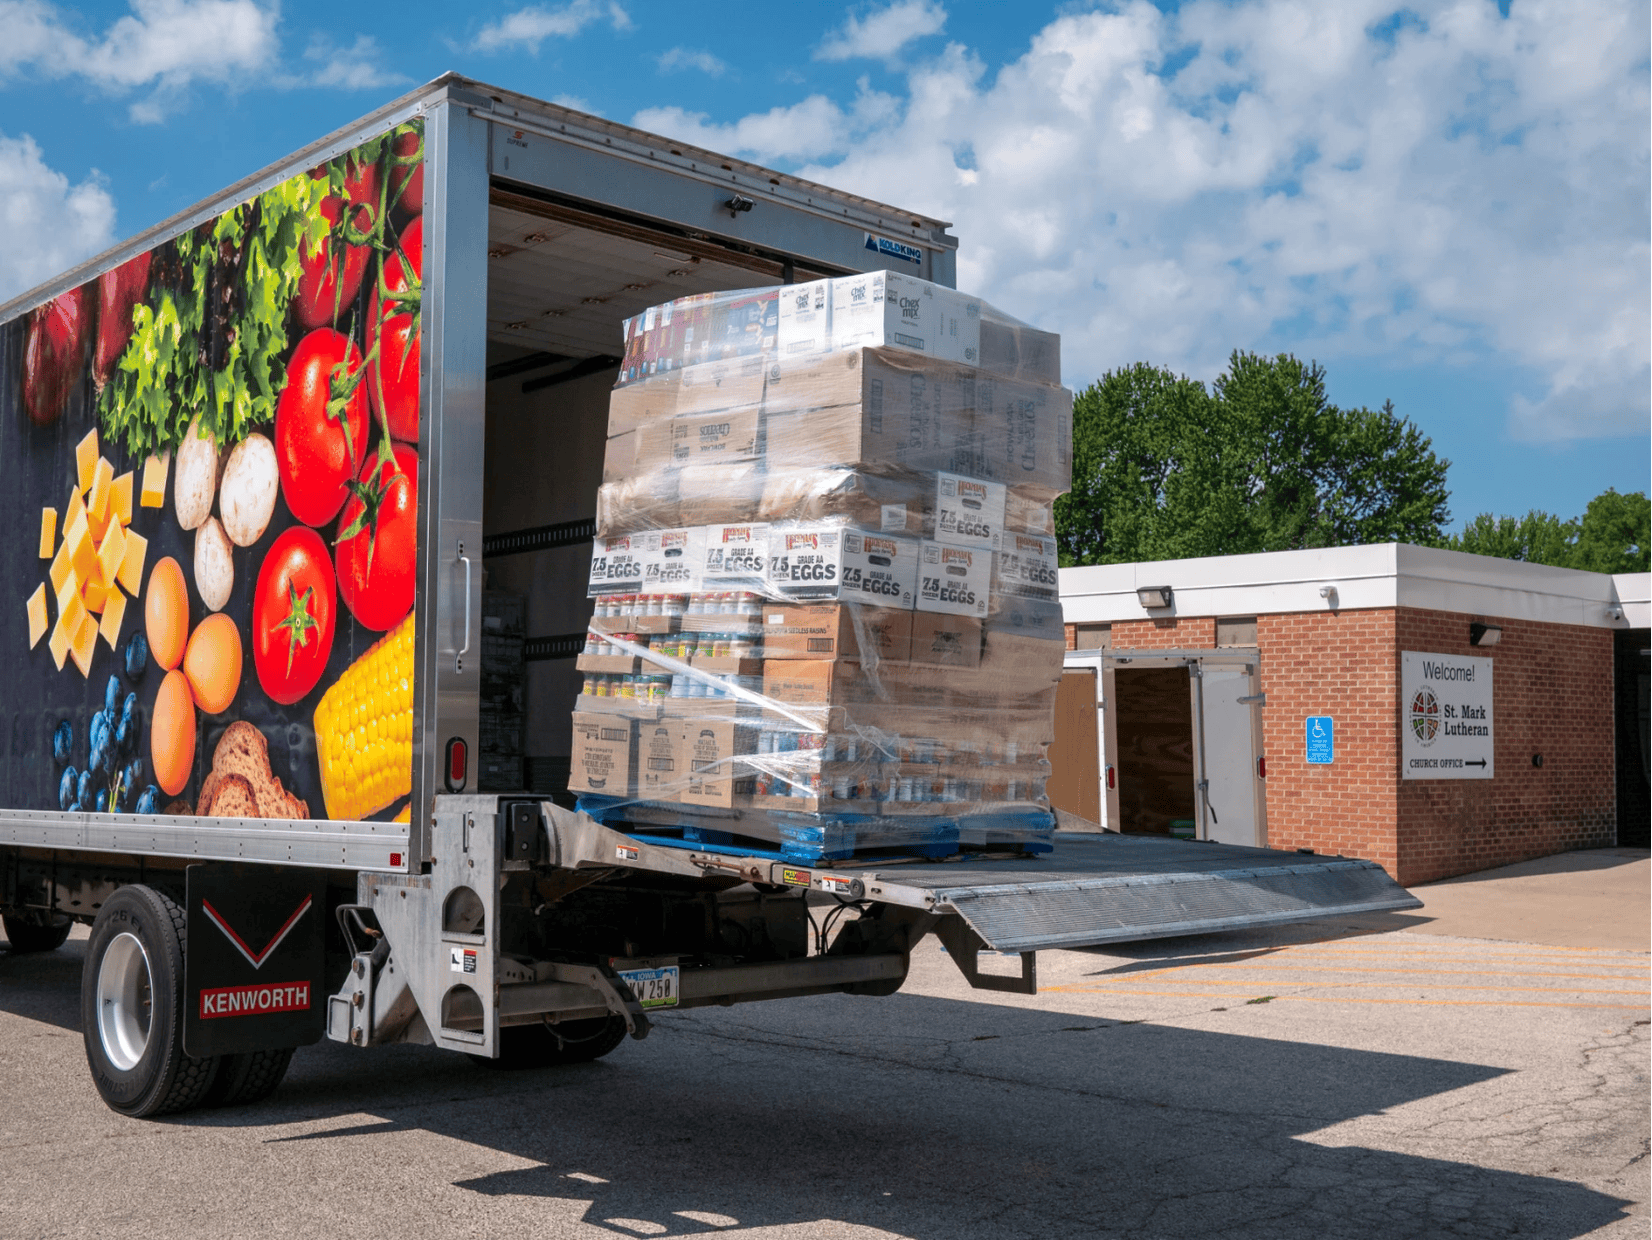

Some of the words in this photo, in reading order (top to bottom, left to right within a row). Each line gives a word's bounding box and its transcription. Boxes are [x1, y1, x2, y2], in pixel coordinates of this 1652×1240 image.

[506, 137, 529, 149] SUPREME
[900, 297, 920, 310] Chex
[902, 308, 920, 320] mix
[940, 509, 956, 524] 7.5
[957, 520, 990, 538] EGGS
[731, 548, 746, 556] GRADE
[747, 548, 754, 556] AA
[797, 555, 814, 564] GRADE
[816, 555, 824, 564] AA
[592, 556, 607, 571] 7.5
[607, 562, 641, 578] EGGS
[724, 556, 764, 572] EGGS
[771, 556, 789, 572] 7.5
[791, 564, 836, 580] EGGS
[843, 566, 862, 582] 7.5
[870, 570, 885, 580] GRADE
[1020, 565, 1056, 585] EGGS
[862, 578, 900, 596] EGGS
[922, 577, 940, 592] 7.5
[940, 588, 976, 605] EGGS
[1423, 661, 1475, 682] Welcome!
[1444, 704, 1458, 718] St.
[1461, 704, 1486, 720] Mark
[1444, 722, 1489, 736] Lutheran
[1410, 759, 1438, 768] CHURCH
[1440, 759, 1464, 768] OFFICE
[638, 972, 656, 980] IOWA
[204, 986, 308, 1014] KENWORTH
